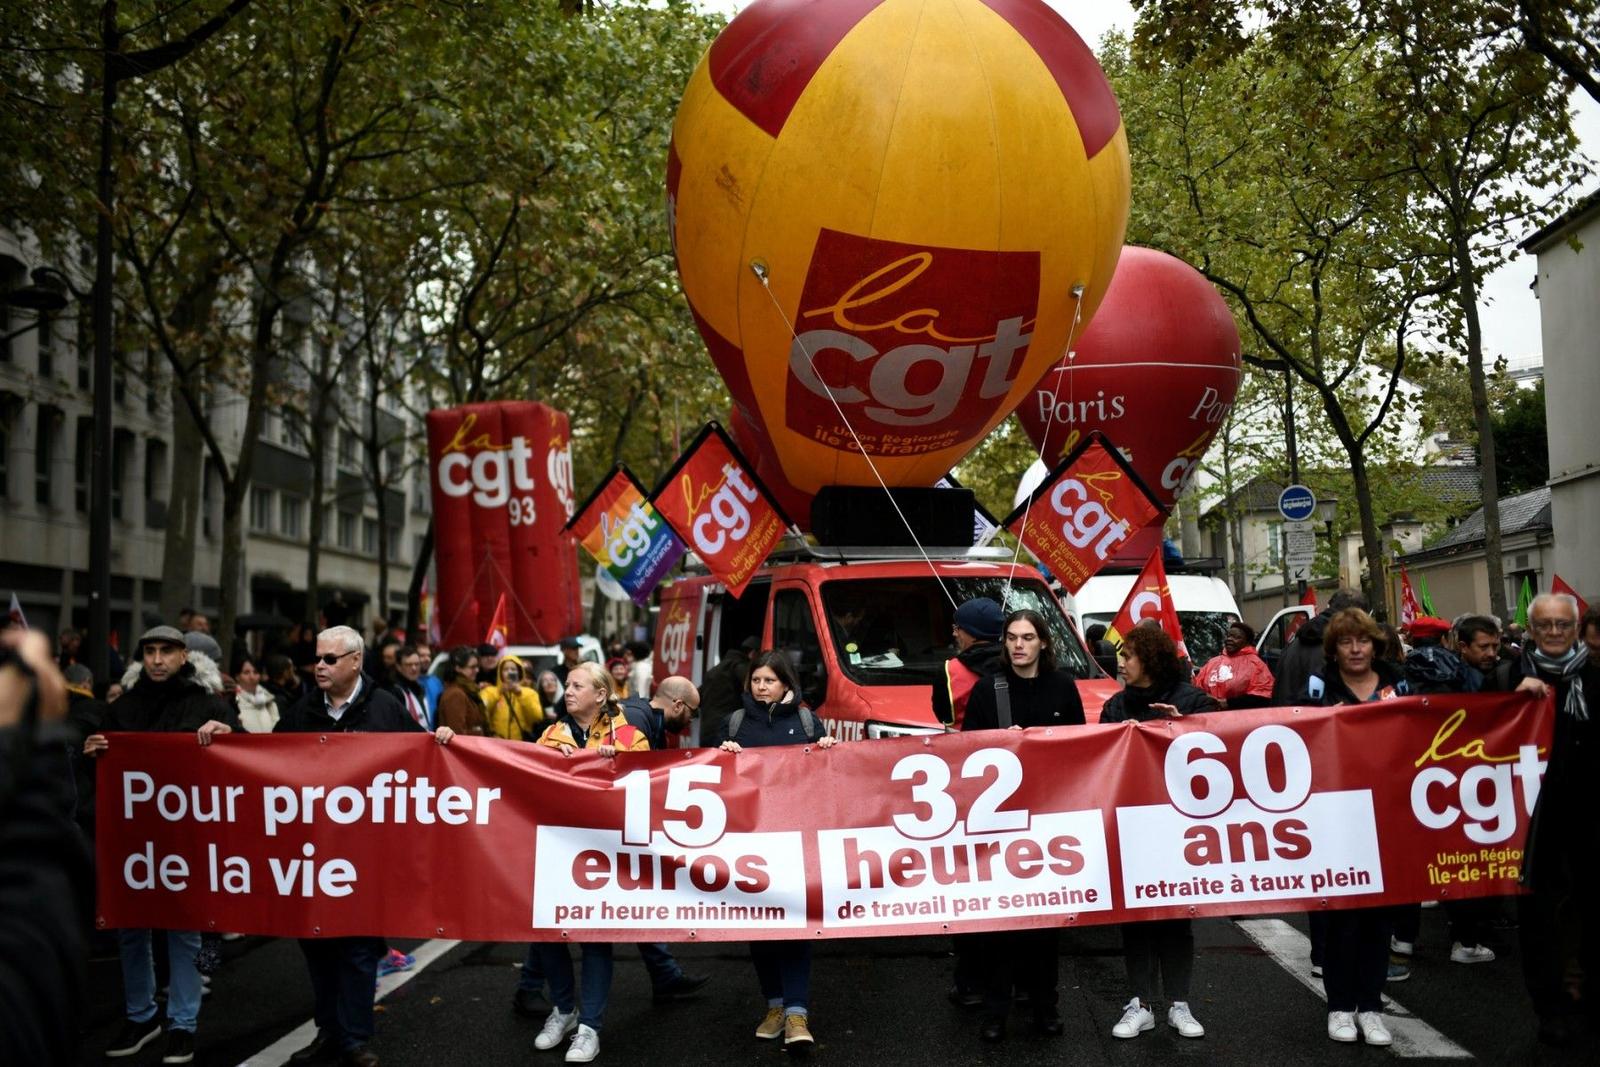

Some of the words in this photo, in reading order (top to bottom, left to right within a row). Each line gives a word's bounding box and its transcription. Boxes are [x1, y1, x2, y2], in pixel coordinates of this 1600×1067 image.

[803, 252, 1036, 342] la
[790, 316, 1030, 426] cgt
[1037, 390, 1125, 422] Paris
[1189, 386, 1232, 422] Par
[442, 413, 531, 453] la
[834, 425, 876, 442] Union
[438, 436, 535, 508] cgt
[509, 496, 536, 526] 93
[608, 502, 658, 567] cgt
[693, 463, 758, 555] cgt
[1039, 520, 1060, 545] Union
[1051, 478, 1131, 560] cgt
[660, 612, 690, 675] cgt
[1414, 709, 1547, 768] la
[890, 747, 1030, 839] 32
[1164, 724, 1312, 818] 60
[1410, 744, 1548, 844] cgt
[122, 771, 244, 822] Pour
[263, 769, 501, 836] profiter
[612, 764, 727, 846] 15
[123, 841, 190, 891] de
[208, 843, 251, 894] la
[269, 842, 357, 897] vie
[843, 835, 1085, 889] heures
[1183, 818, 1312, 867] ans
[1436, 851, 1478, 866] Union
[1480, 847, 1524, 864] Régio
[571, 849, 771, 893] euros
[1135, 876, 1225, 899] retraite
[1230, 874, 1245, 893] à
[1250, 874, 1305, 892] taux
[1311, 867, 1371, 892] plein
[1427, 862, 1520, 885] Île-de-Fra
[555, 904, 595, 924] par
[601, 901, 670, 921] heure
[676, 901, 785, 921] minimum
[838, 901, 866, 919] de
[871, 896, 946, 919] travail
[953, 895, 991, 917] par
[997, 886, 1098, 909] semaine
